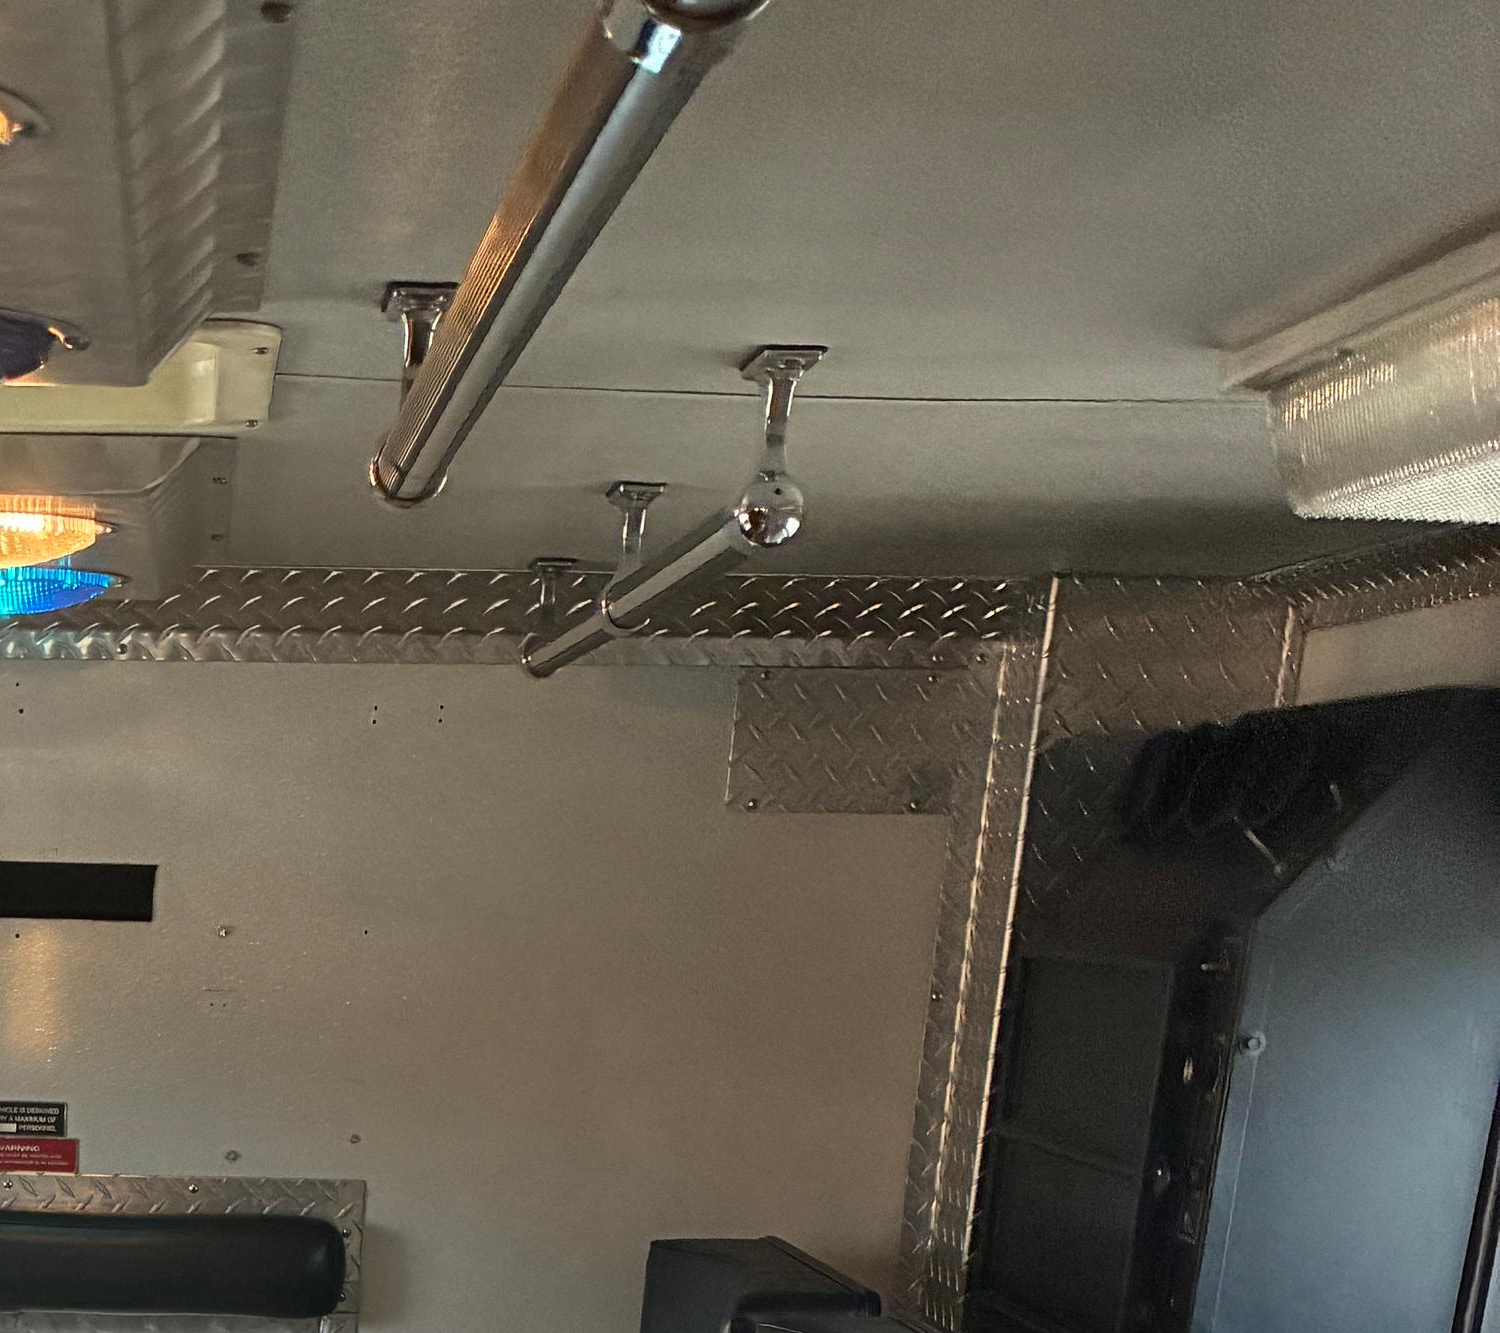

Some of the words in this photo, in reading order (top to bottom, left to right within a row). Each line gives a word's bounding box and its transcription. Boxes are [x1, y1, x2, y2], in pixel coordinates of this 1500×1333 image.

[27, 1107, 60, 1115] DESIGNED
[14, 1115, 46, 1123] MAXIMUM
[18, 1124, 57, 1132] PERSONNEL
